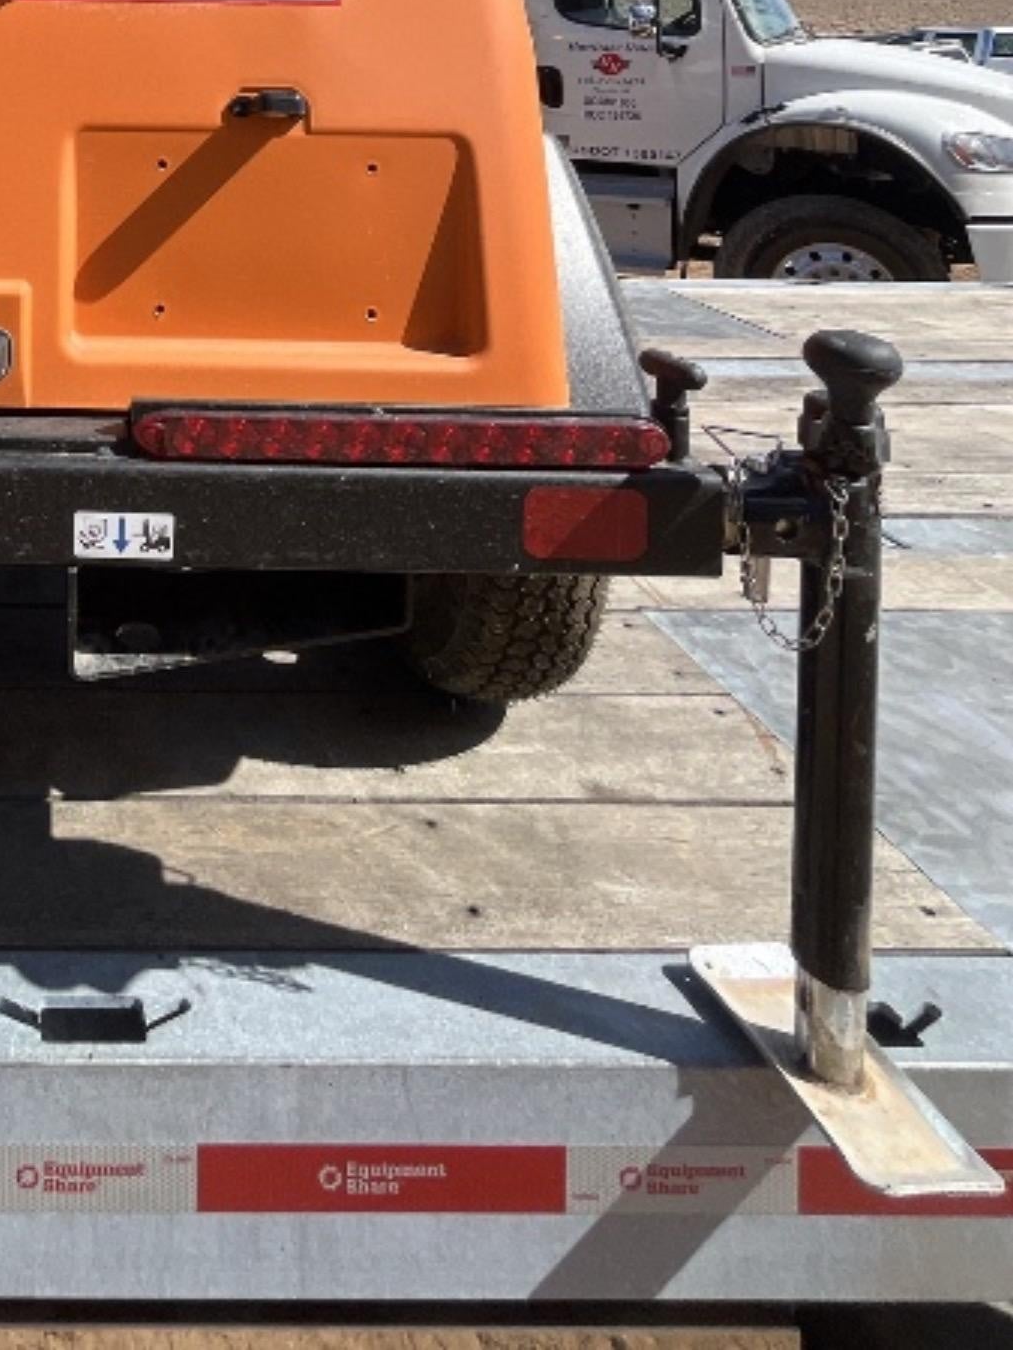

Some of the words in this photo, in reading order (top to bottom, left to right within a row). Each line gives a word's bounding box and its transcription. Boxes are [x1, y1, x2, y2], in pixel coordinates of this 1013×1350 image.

[43, 1160, 144, 1179] Equipment
[345, 1161, 448, 1179] Equipment
[646, 1163, 747, 1180] Equipment
[43, 1178, 97, 1193] Share
